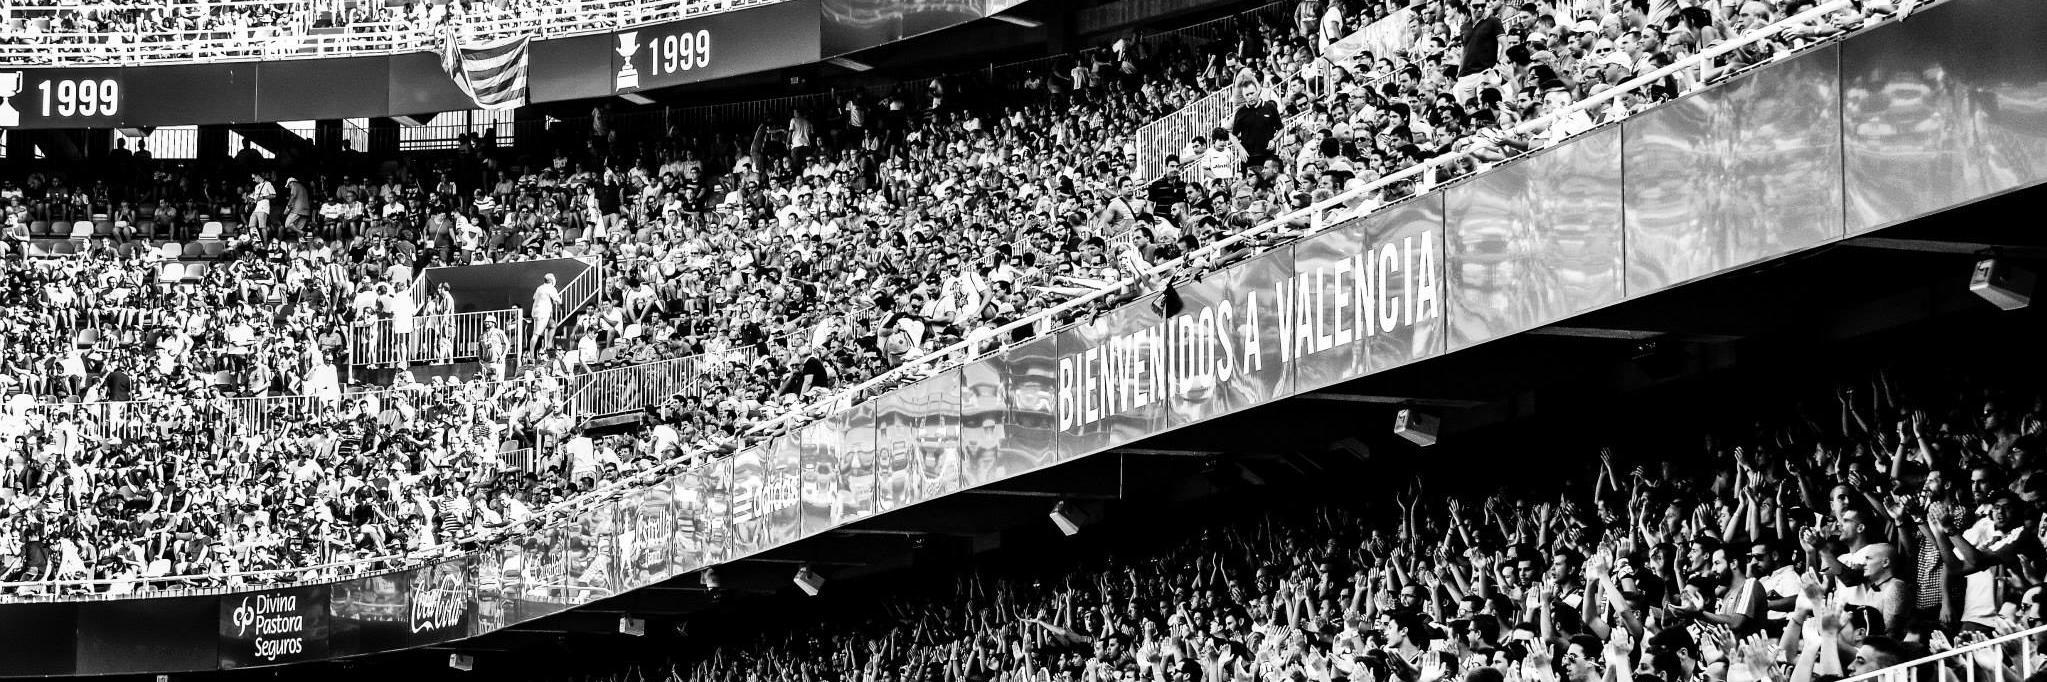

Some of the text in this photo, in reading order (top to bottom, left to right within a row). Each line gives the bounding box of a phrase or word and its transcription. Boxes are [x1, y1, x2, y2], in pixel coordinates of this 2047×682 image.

[647, 29, 711, 76] 1999
[38, 78, 119, 117] 1999
[1058, 229, 1440, 433] BIENVENIDOS A VALENCIA
[256, 594, 297, 614] Divina
[255, 614, 303, 636] Pastora
[254, 637, 303, 661] Seguros
